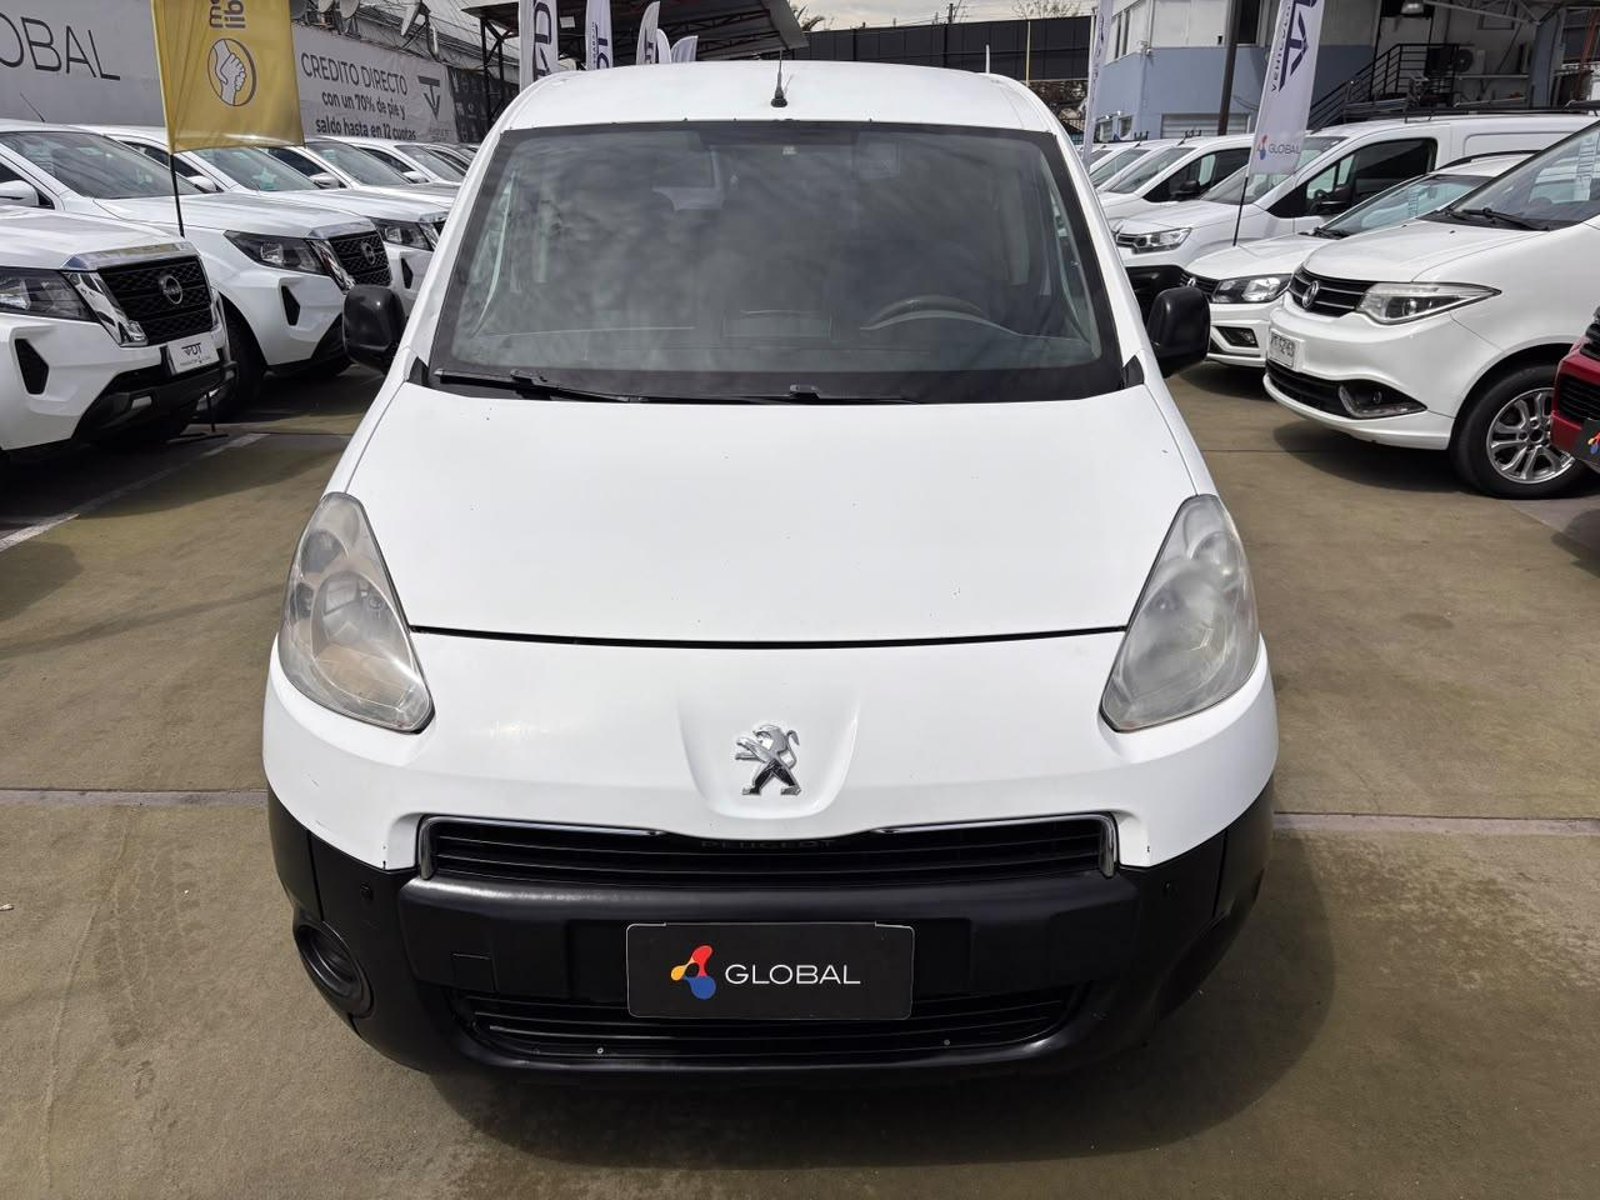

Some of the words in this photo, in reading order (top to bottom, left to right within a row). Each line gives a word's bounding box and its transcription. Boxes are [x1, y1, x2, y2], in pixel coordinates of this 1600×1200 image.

[301, 52, 359, 86] CREDITO
[361, 66, 408, 96] DIRECTO
[322, 91, 340, 107] con
[341, 95, 355, 109] un
[355, 94, 375, 112] 70%
[376, 97, 387, 114] de
[387, 99, 400, 119] pie
[400, 105, 406, 120] y
[316, 116, 341, 134] saldo
[343, 117, 369, 137] hasta
[370, 125, 382, 138] en
[382, 123, 392, 139] 12
[392, 127, 416, 141] cuotas
[724, 964, 861, 985] GLOBAL
